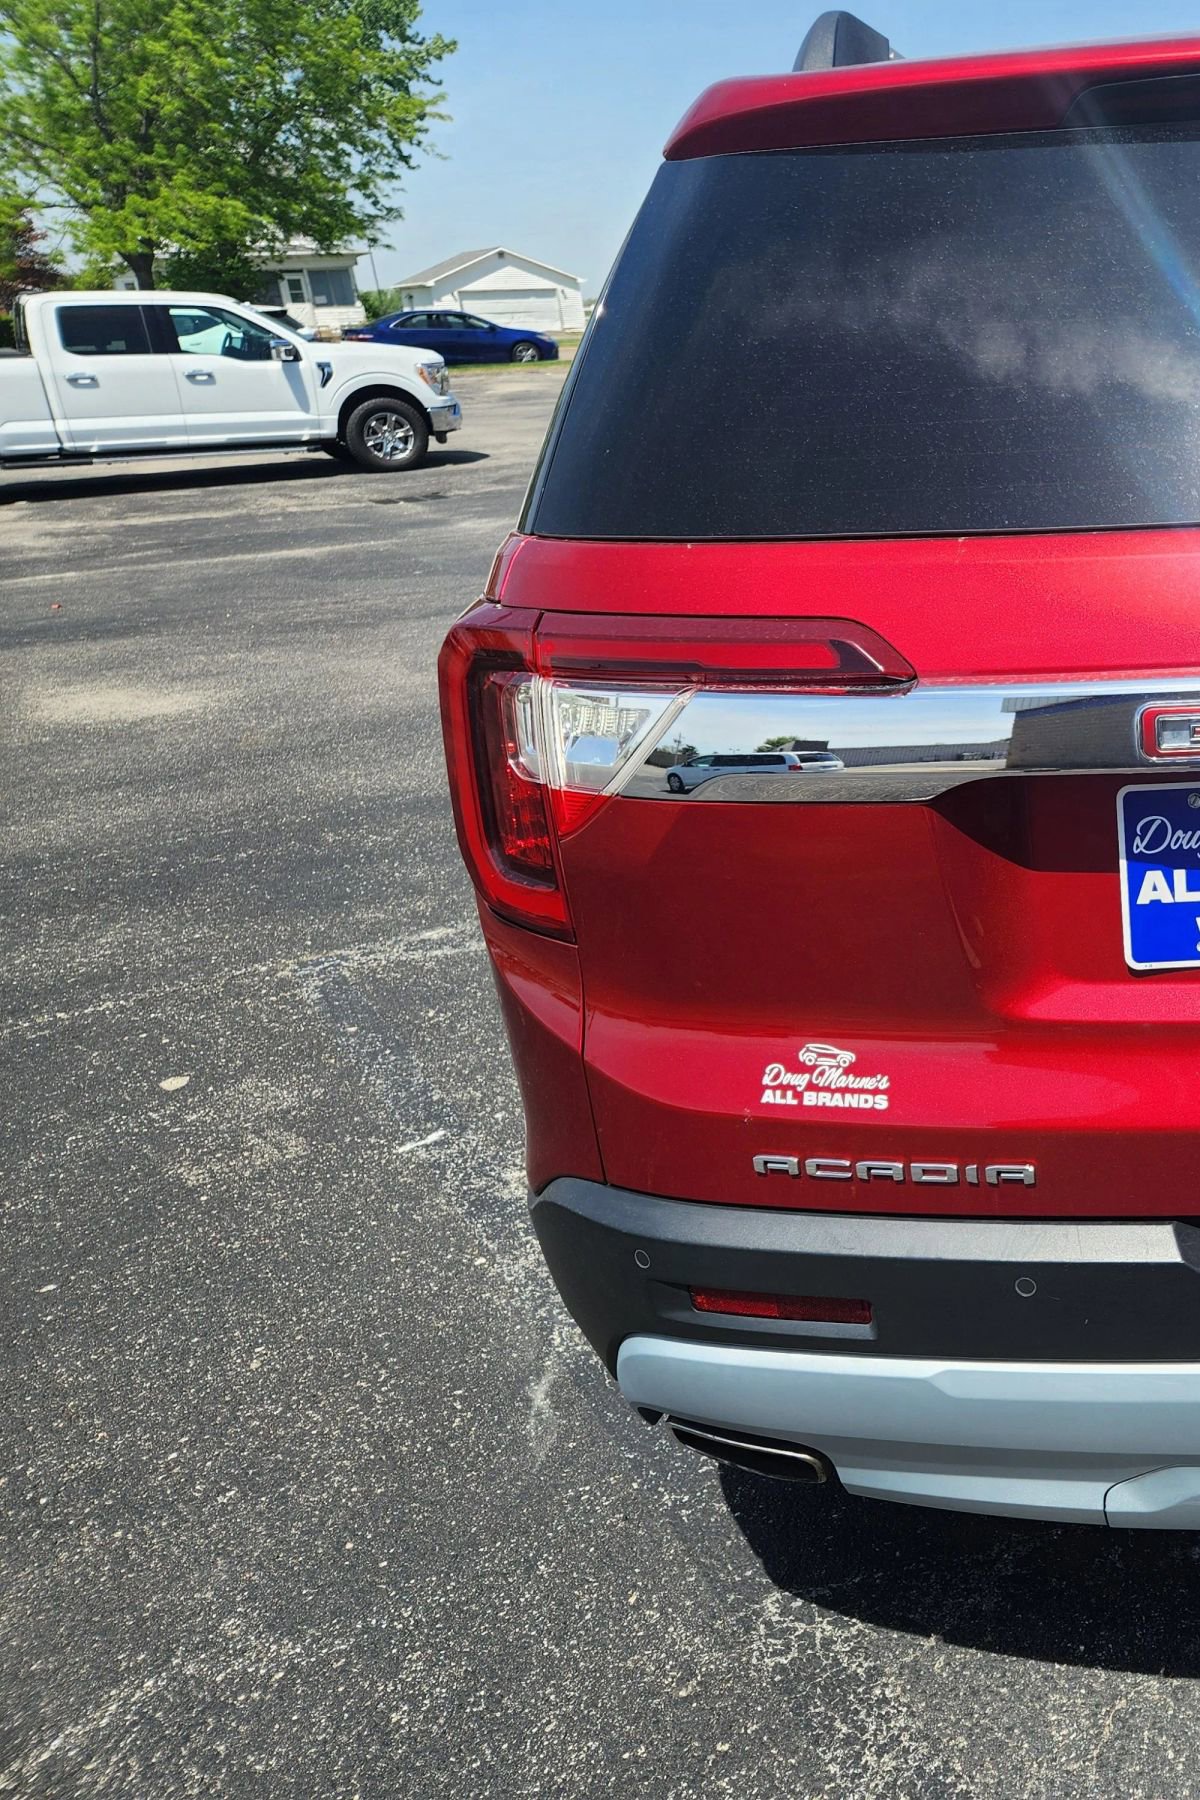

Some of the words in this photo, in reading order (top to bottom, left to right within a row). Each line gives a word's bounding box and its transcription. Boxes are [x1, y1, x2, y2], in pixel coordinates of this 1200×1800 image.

[762, 1063, 810, 1091] Doug
[811, 1065, 890, 1090] Marine's
[760, 1089, 799, 1105] ALL
[802, 1091, 889, 1110] BRANDS
[752, 1154, 1036, 1186] ACADIA
